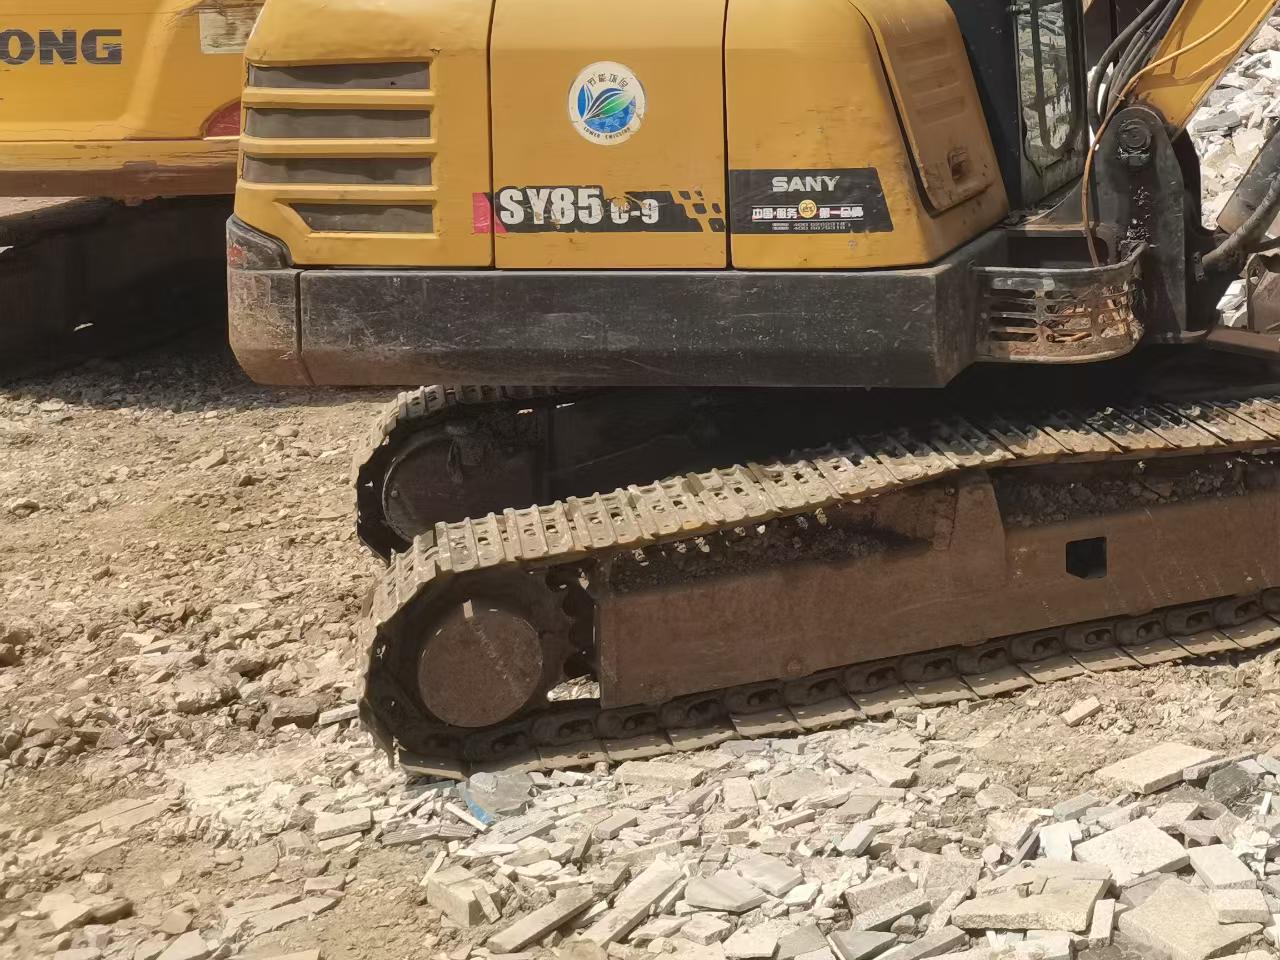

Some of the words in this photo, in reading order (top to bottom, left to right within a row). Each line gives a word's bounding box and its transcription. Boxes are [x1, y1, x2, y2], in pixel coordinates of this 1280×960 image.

[0, 29, 122, 65] ONG
[771, 176, 841, 192] SANY
[500, 188, 604, 225] SY85
